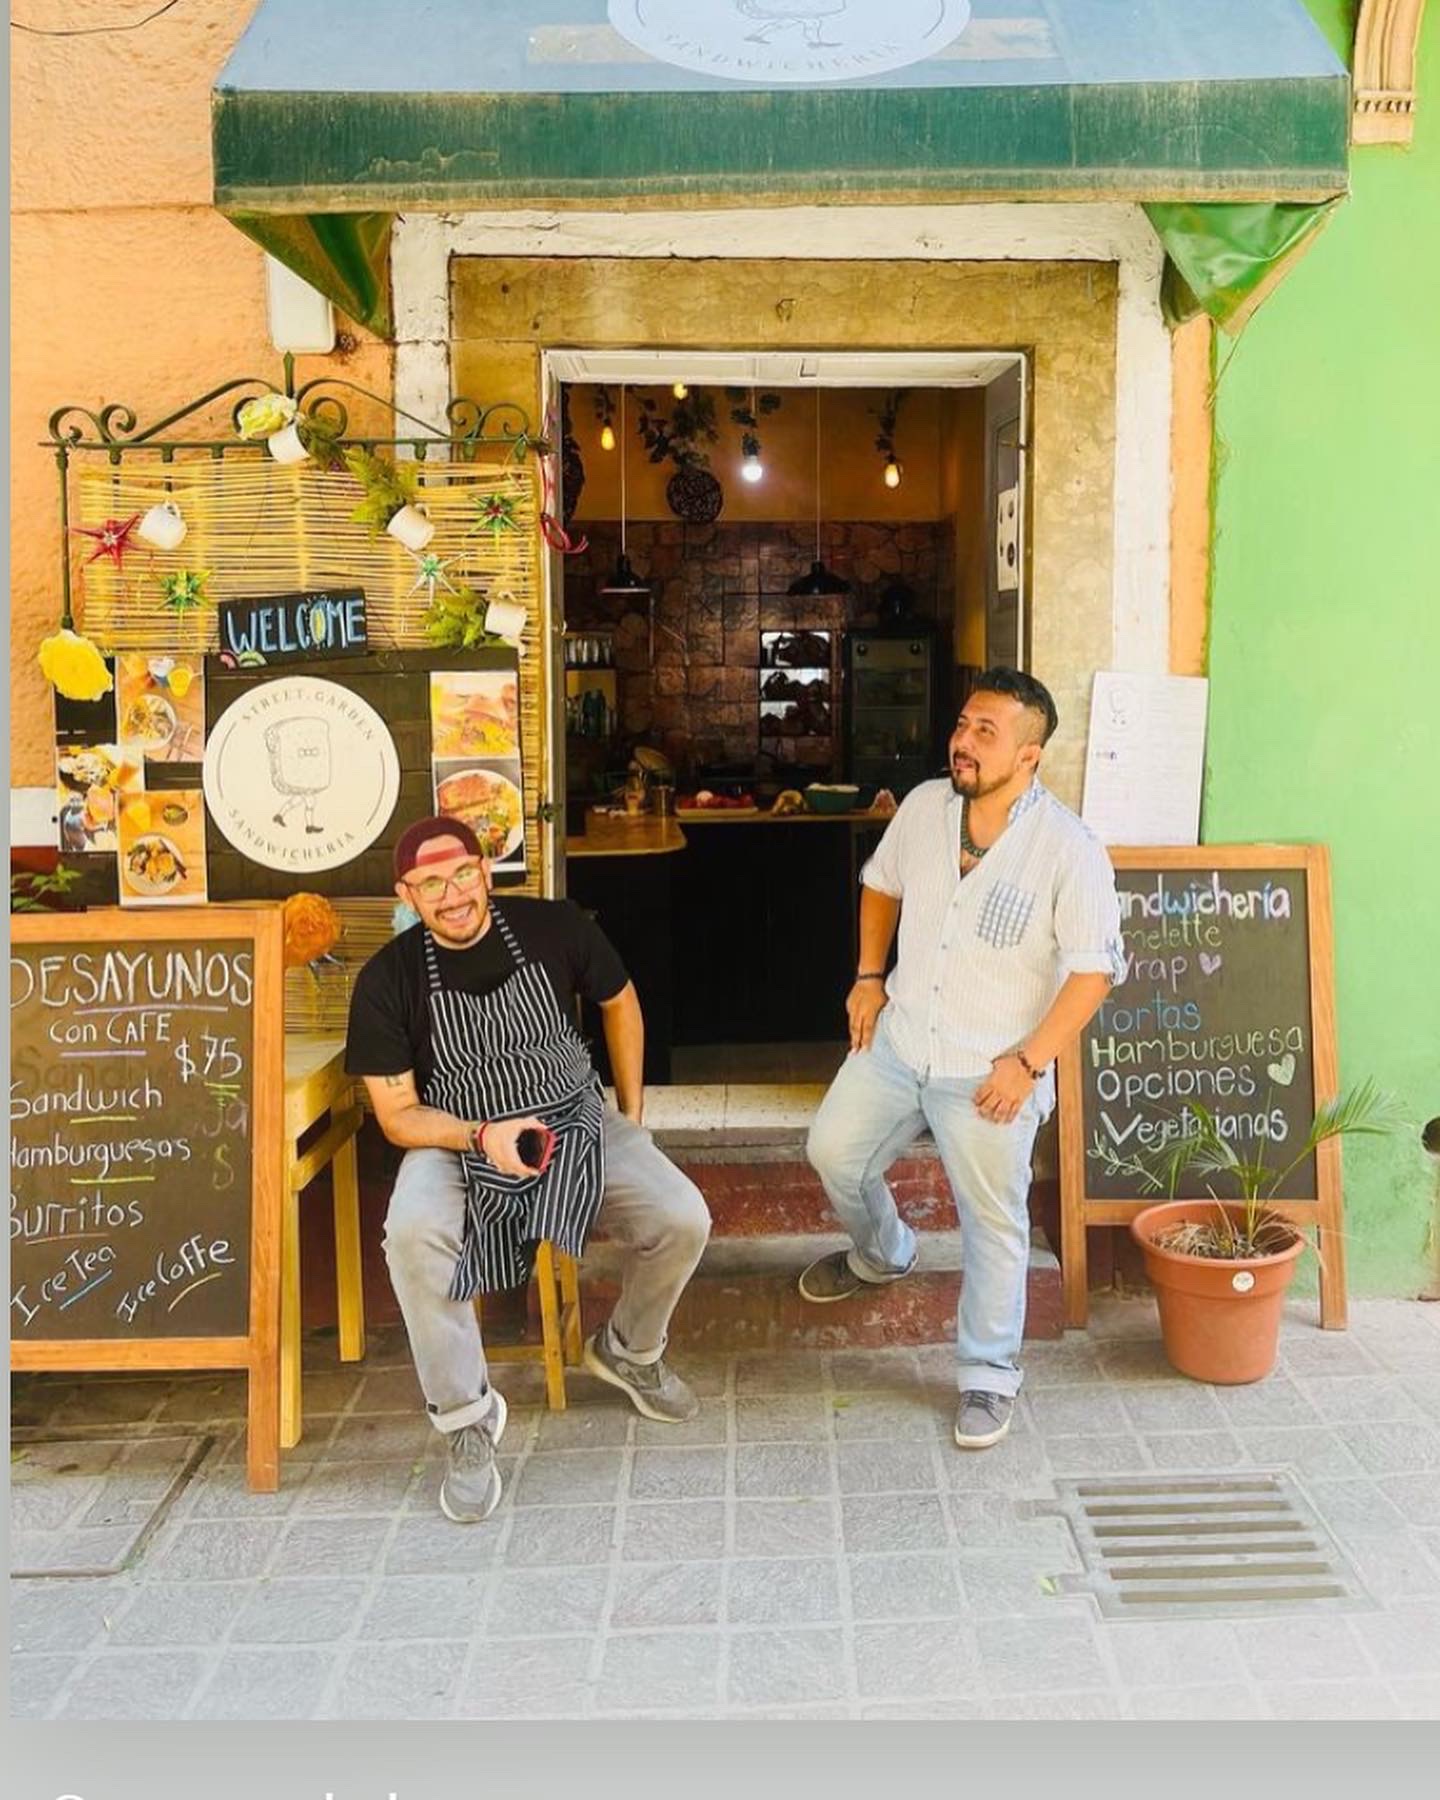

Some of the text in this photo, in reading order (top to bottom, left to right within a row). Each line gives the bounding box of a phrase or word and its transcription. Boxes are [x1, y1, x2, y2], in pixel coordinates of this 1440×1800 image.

[227, 599, 365, 653] WELCOME
[1121, 912, 1223, 950] melette
[10, 949, 253, 1007] DESAYUNOS
[1126, 951, 1187, 992] rap
[106, 1011, 172, 1045] CAFE
[1091, 1025, 1305, 1068] Hamburguesa
[10, 1073, 162, 1120] Sandwich
[1097, 1064, 1256, 1107] Opciones
[1100, 1105, 1289, 1152] Vegetaianas
